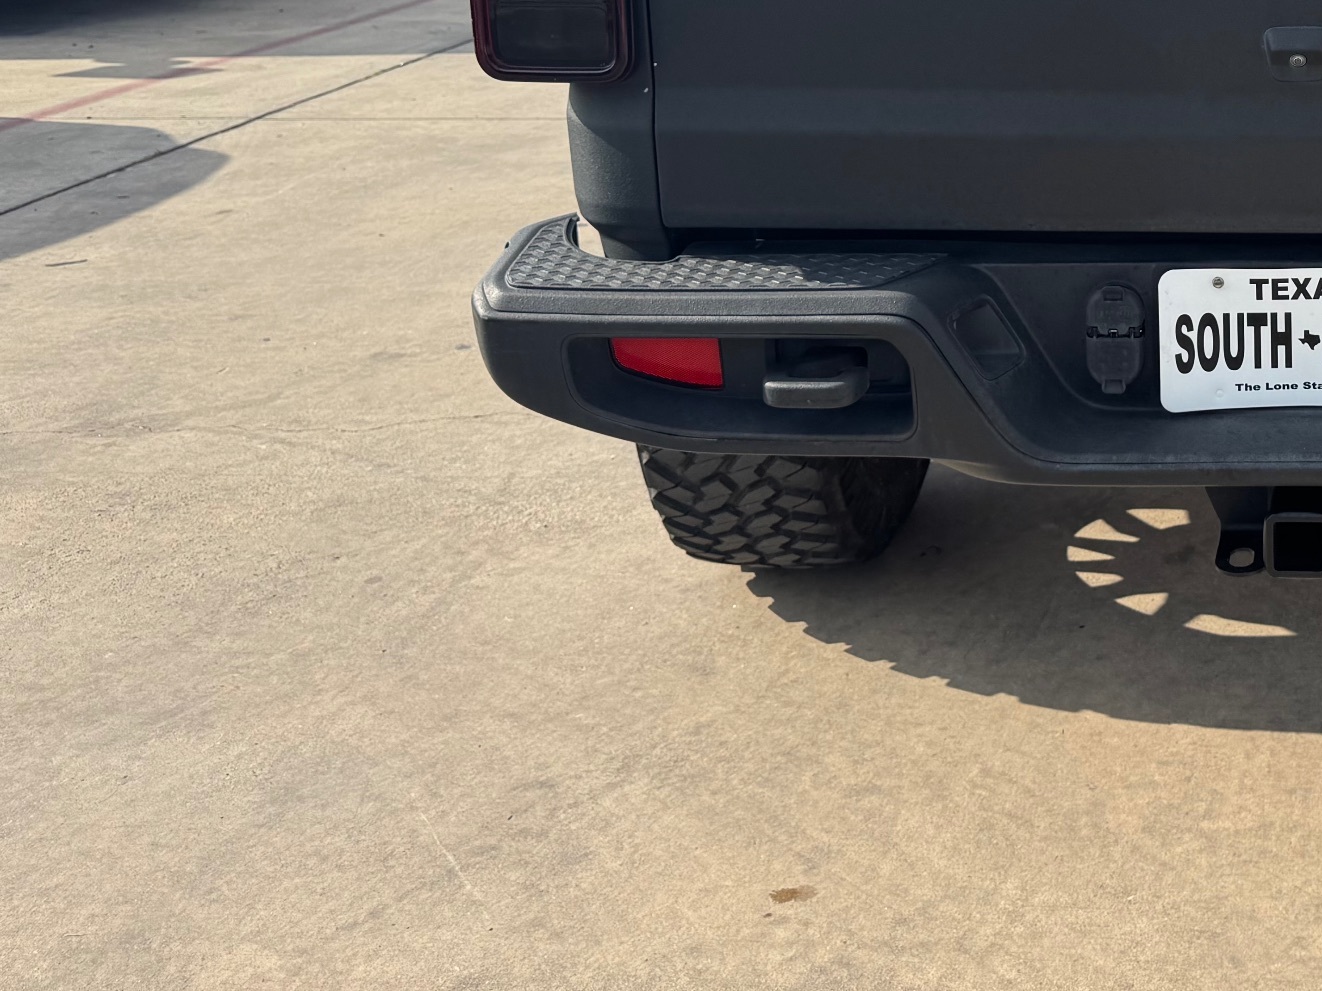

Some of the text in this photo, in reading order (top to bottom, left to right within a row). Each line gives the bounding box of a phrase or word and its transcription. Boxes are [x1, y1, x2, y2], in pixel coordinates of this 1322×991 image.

[1174, 311, 1293, 375] SOUTH
[1235, 383, 1262, 393] The
[1265, 381, 1299, 392] Lone
